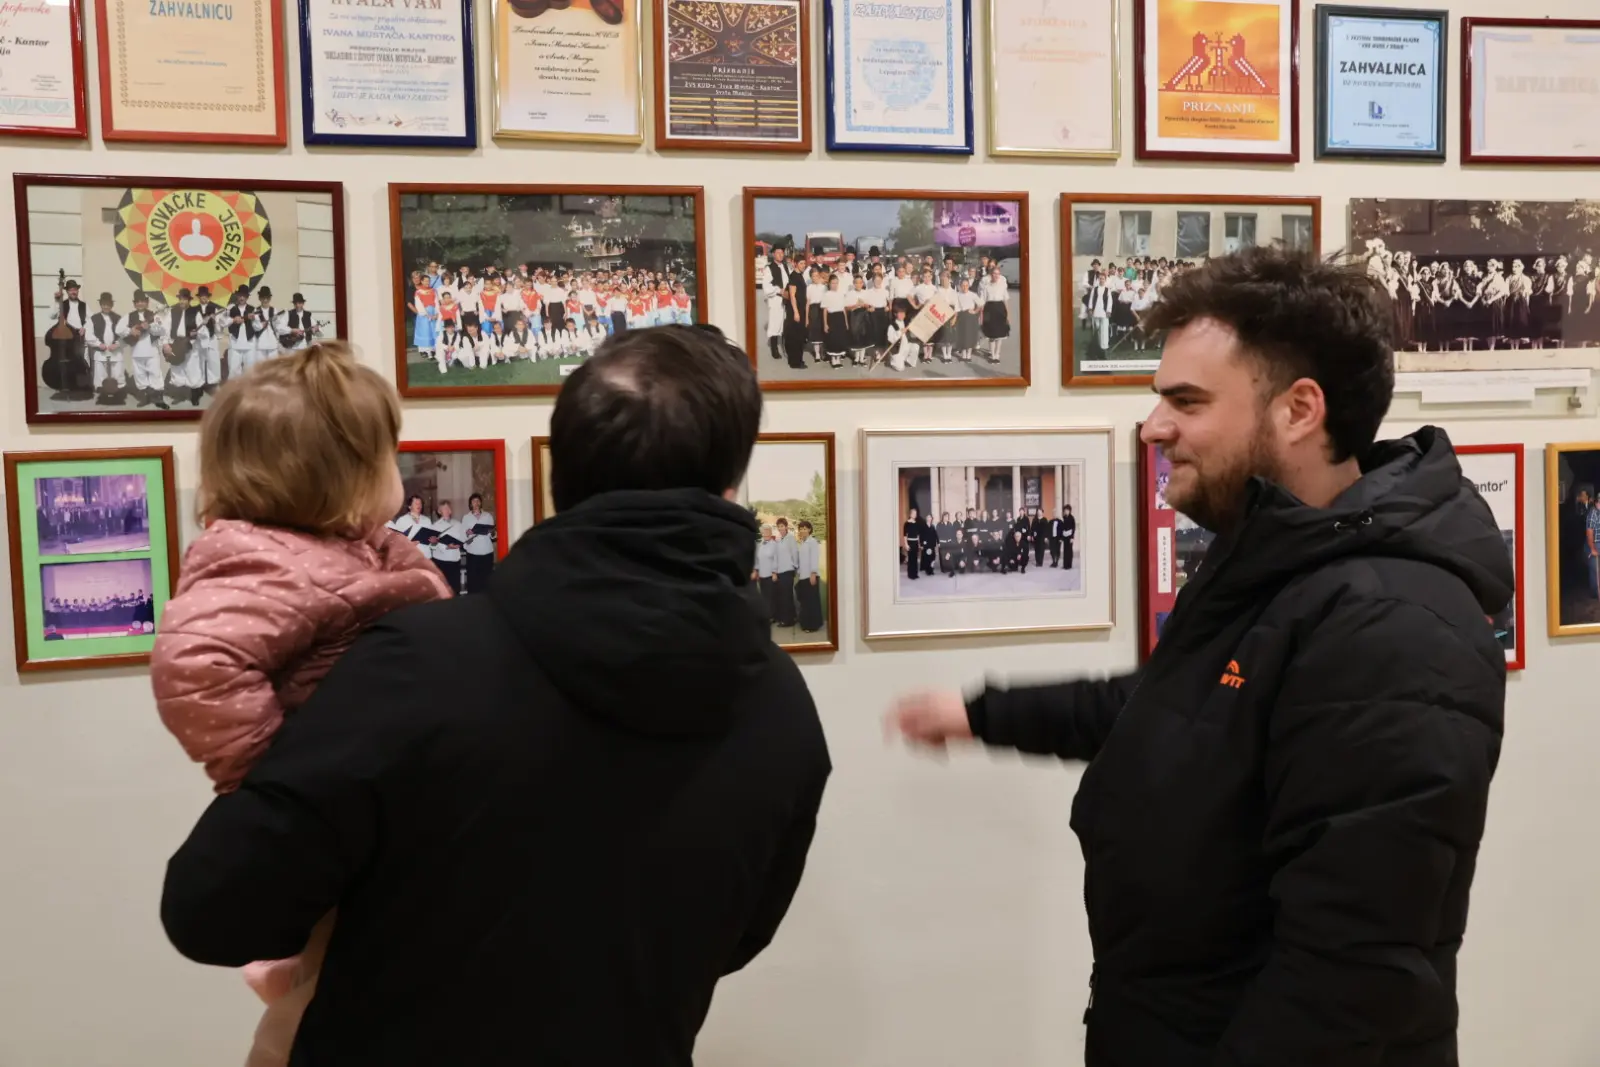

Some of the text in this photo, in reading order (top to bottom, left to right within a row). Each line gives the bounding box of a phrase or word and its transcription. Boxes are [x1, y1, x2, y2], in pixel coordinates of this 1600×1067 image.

[149, 0, 232, 20] ZAHVALNICU
[323, 29, 353, 38] IVANA
[15, 37, 49, 46] Kantor
[1340, 60, 1426, 76] ZAHVALNICA
[1183, 101, 1256, 114] PRIZNANJE
[150, 191, 242, 272] VINKOVAČKE JESENI
[1473, 479, 1508, 492] antor"
